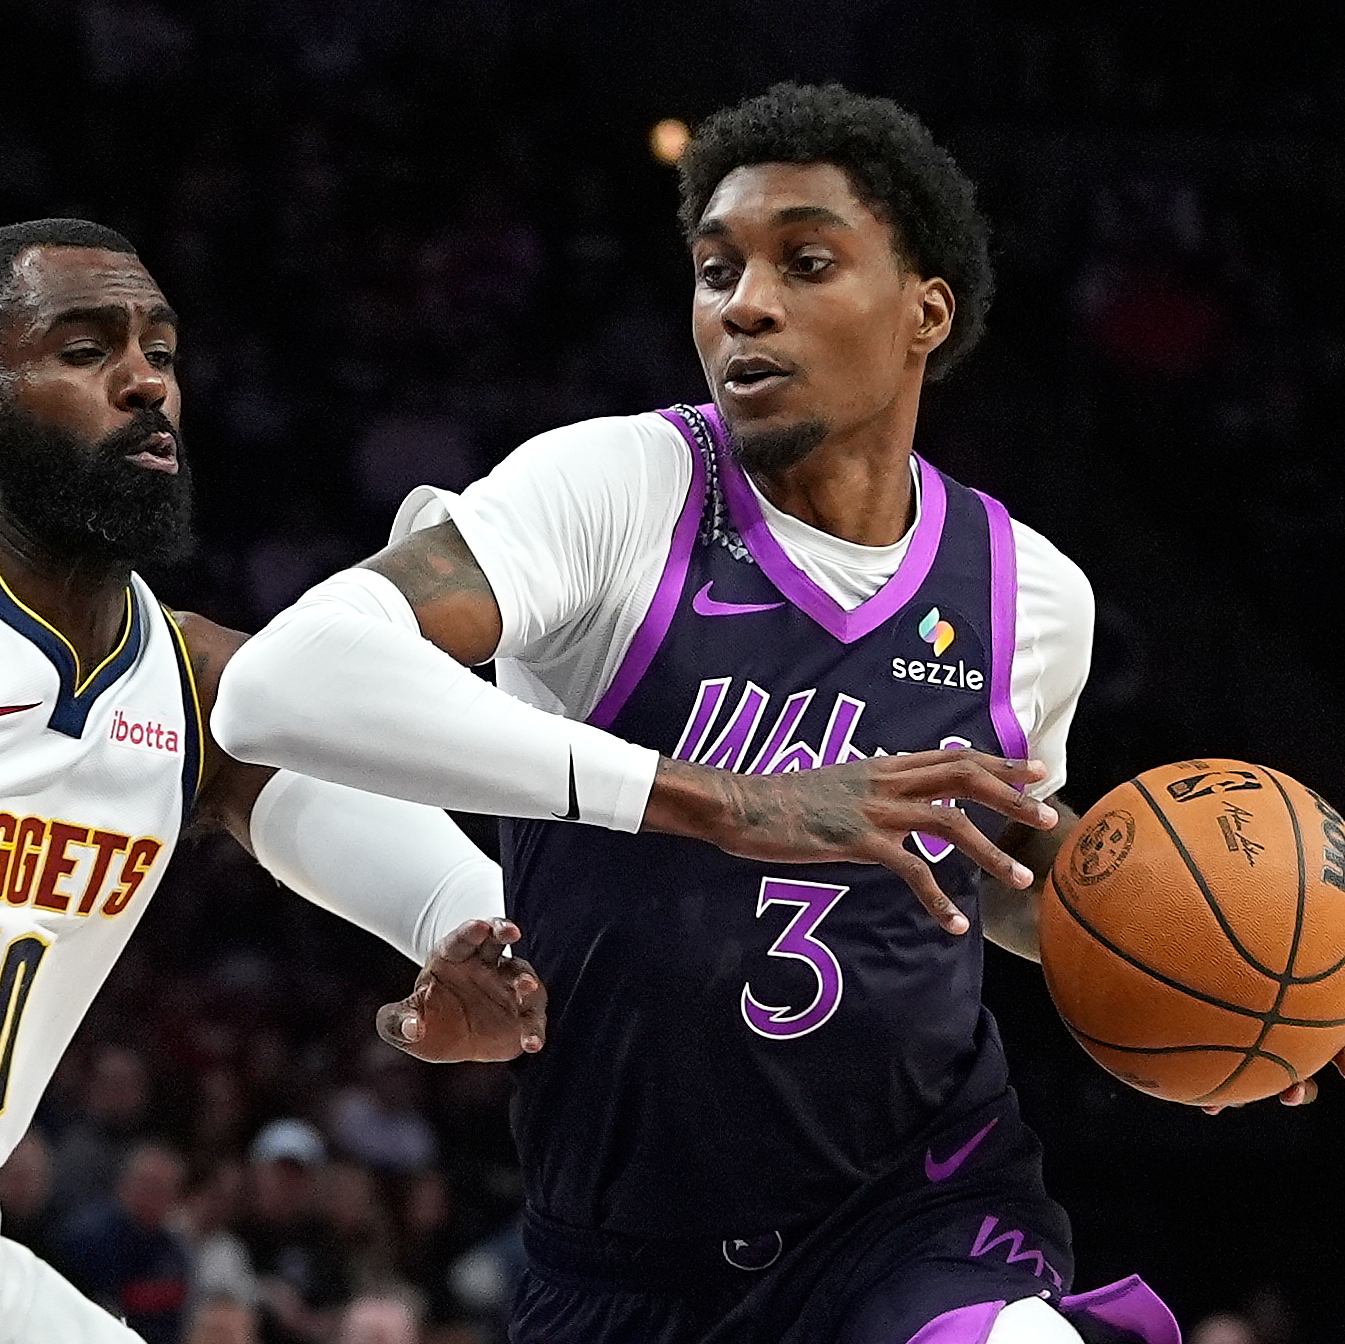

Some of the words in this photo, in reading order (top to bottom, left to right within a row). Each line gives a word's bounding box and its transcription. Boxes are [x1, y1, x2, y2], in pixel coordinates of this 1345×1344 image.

[892, 657, 984, 691] sezzle
[110, 710, 178, 752] ibotta
[741, 876, 849, 1040] 3
